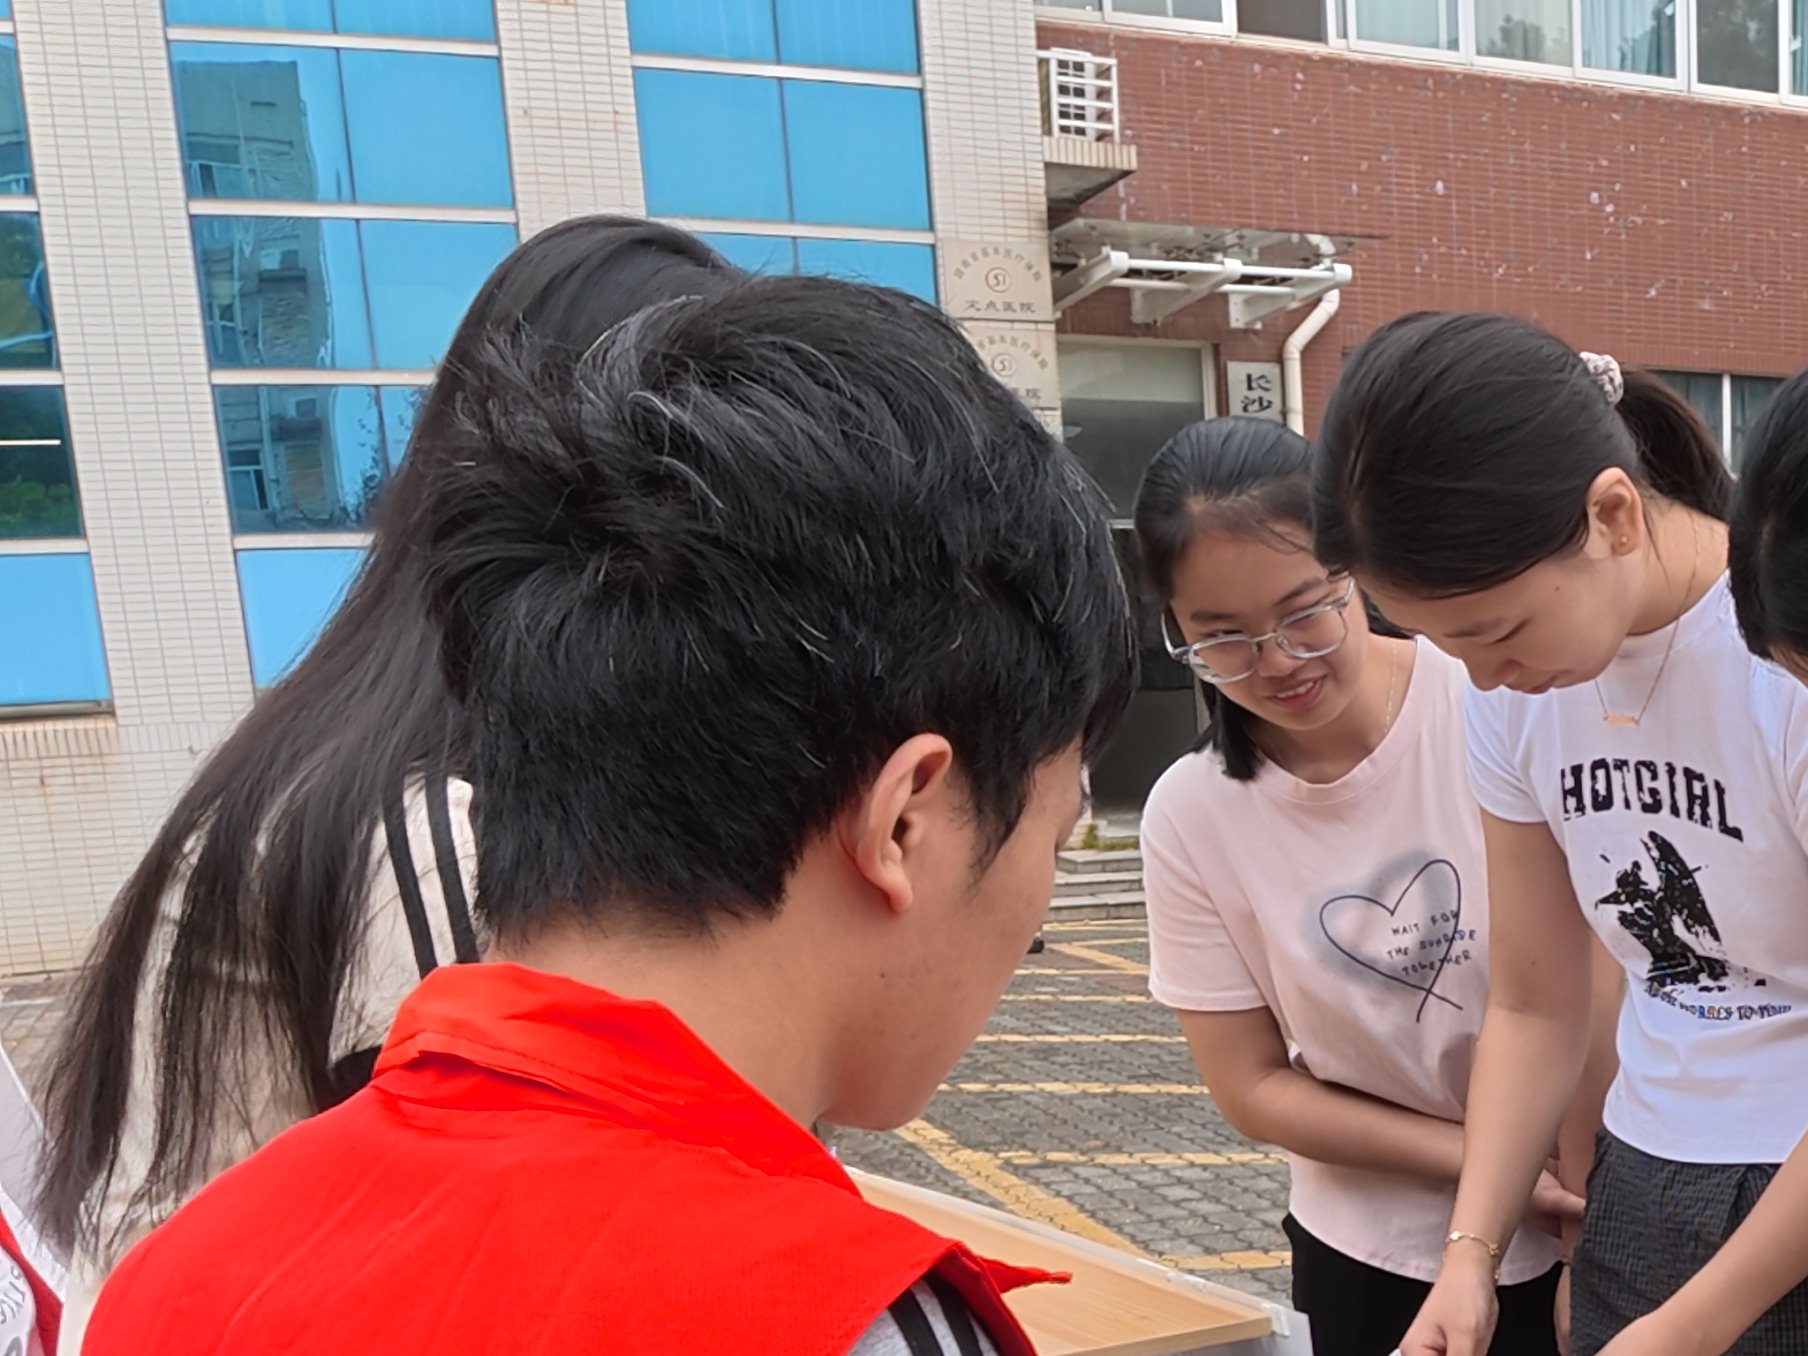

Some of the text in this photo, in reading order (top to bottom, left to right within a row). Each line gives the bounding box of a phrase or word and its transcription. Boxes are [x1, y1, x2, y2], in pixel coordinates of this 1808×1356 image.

[1240, 373, 1274, 414] 长沙
[1560, 757, 1744, 843] HOTGIRL
[1391, 909, 1459, 936] WAIT FOR
[1386, 946, 1409, 960] THE
